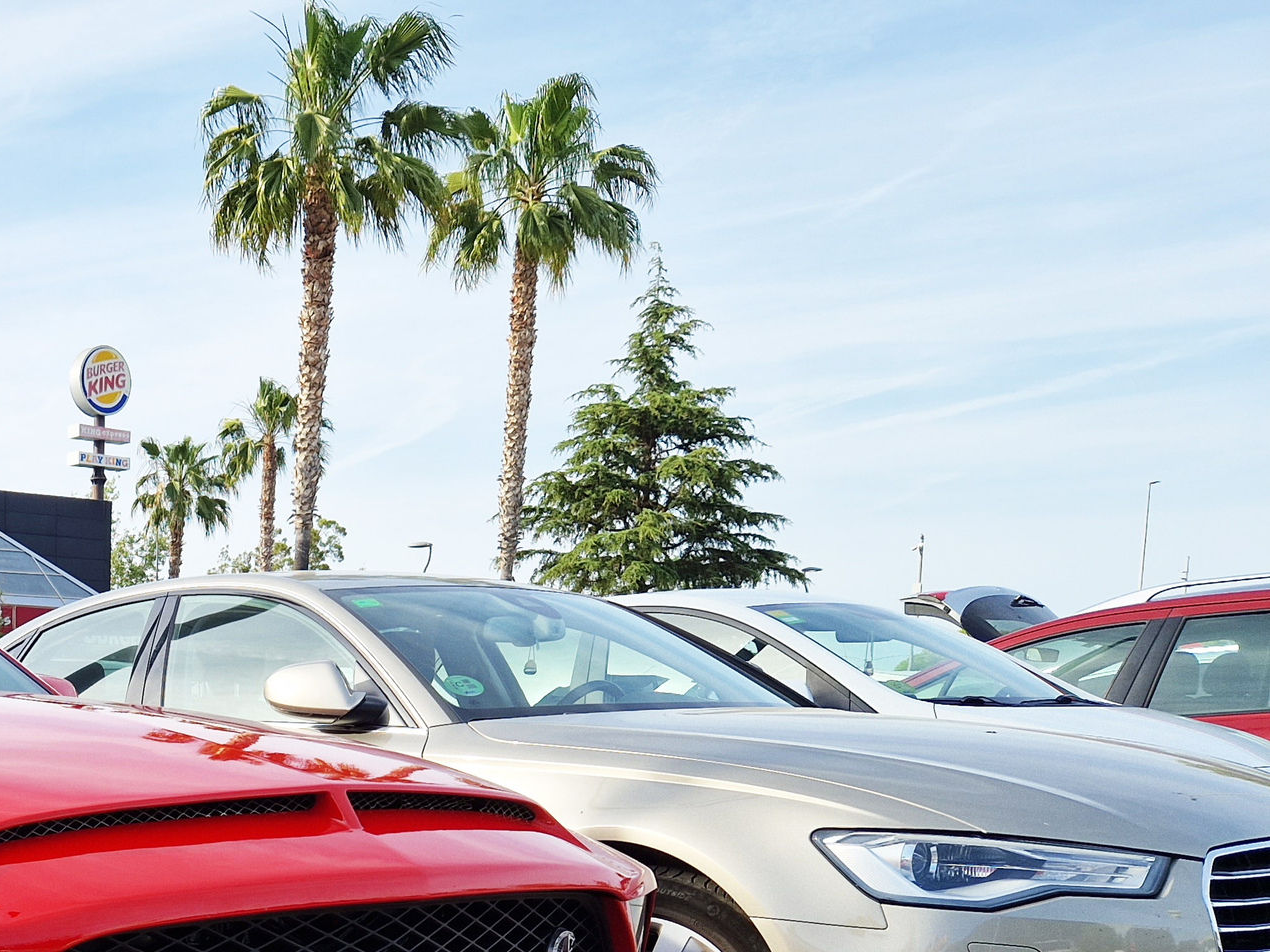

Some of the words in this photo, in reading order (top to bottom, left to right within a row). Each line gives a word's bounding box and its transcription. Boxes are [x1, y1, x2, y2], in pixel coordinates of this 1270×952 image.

[86, 361, 125, 380] BURGER
[87, 373, 126, 398] KING
[81, 426, 101, 436] KING
[80, 453, 103, 464] PLAY
[105, 456, 128, 467] KING
